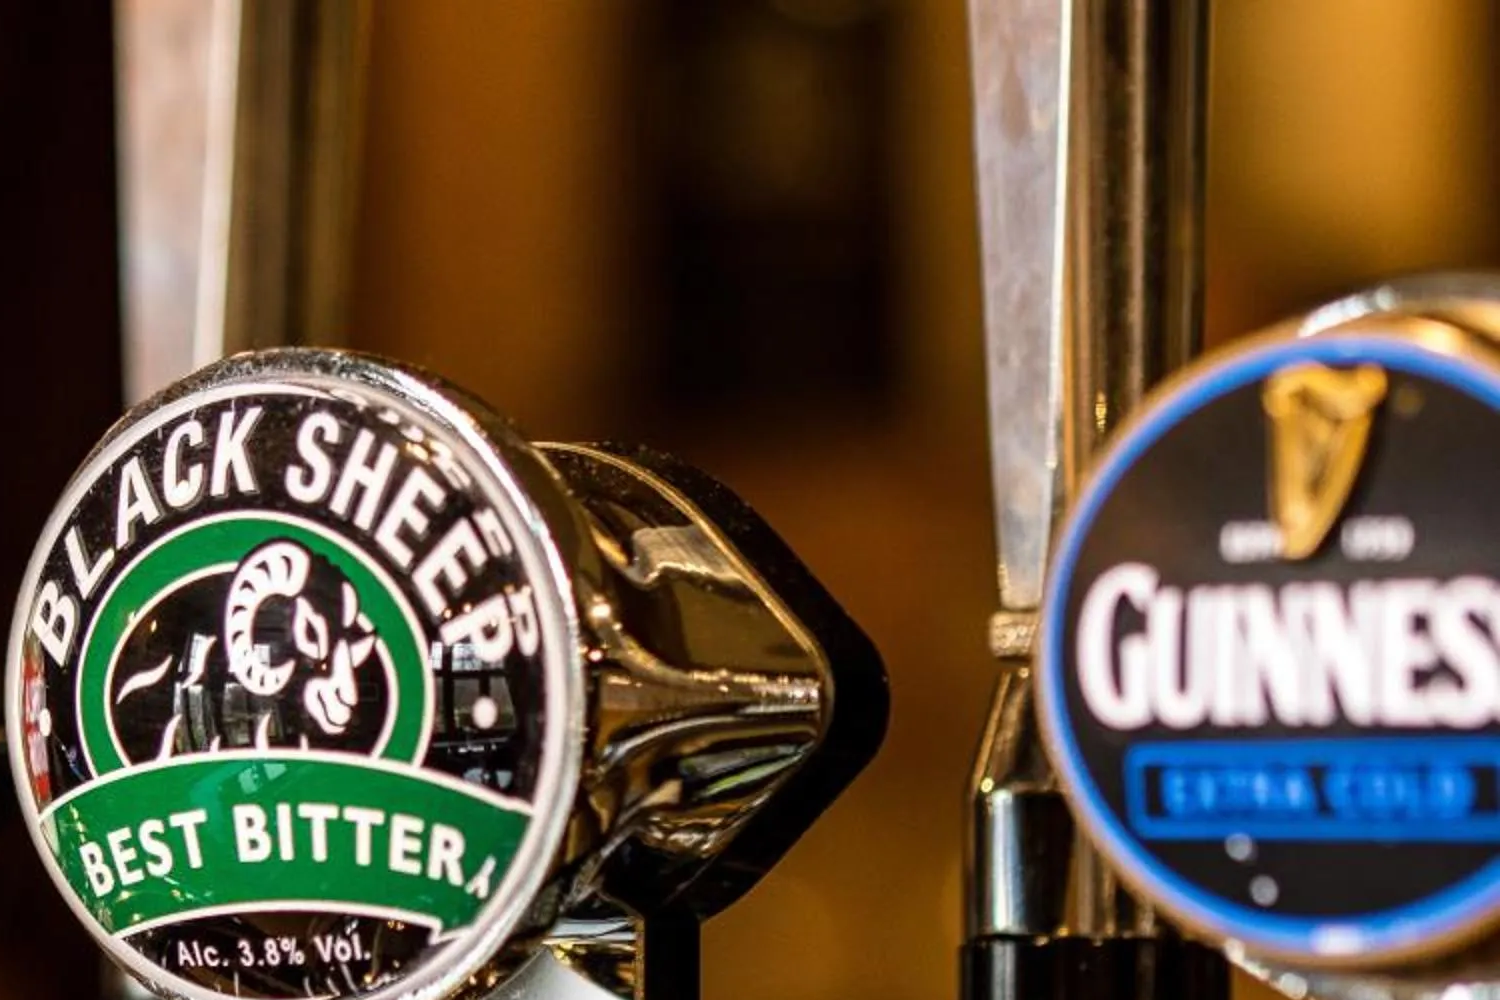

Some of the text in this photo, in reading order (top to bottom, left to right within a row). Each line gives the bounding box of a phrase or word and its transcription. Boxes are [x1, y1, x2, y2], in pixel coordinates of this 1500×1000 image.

[31, 406, 515, 668] BLACK SHEEP
[1076, 562, 1500, 731] GUINNES
[79, 803, 466, 897] BEST BITTER
[176, 940, 230, 968] Alc.
[239, 936, 306, 967] 3.8%
